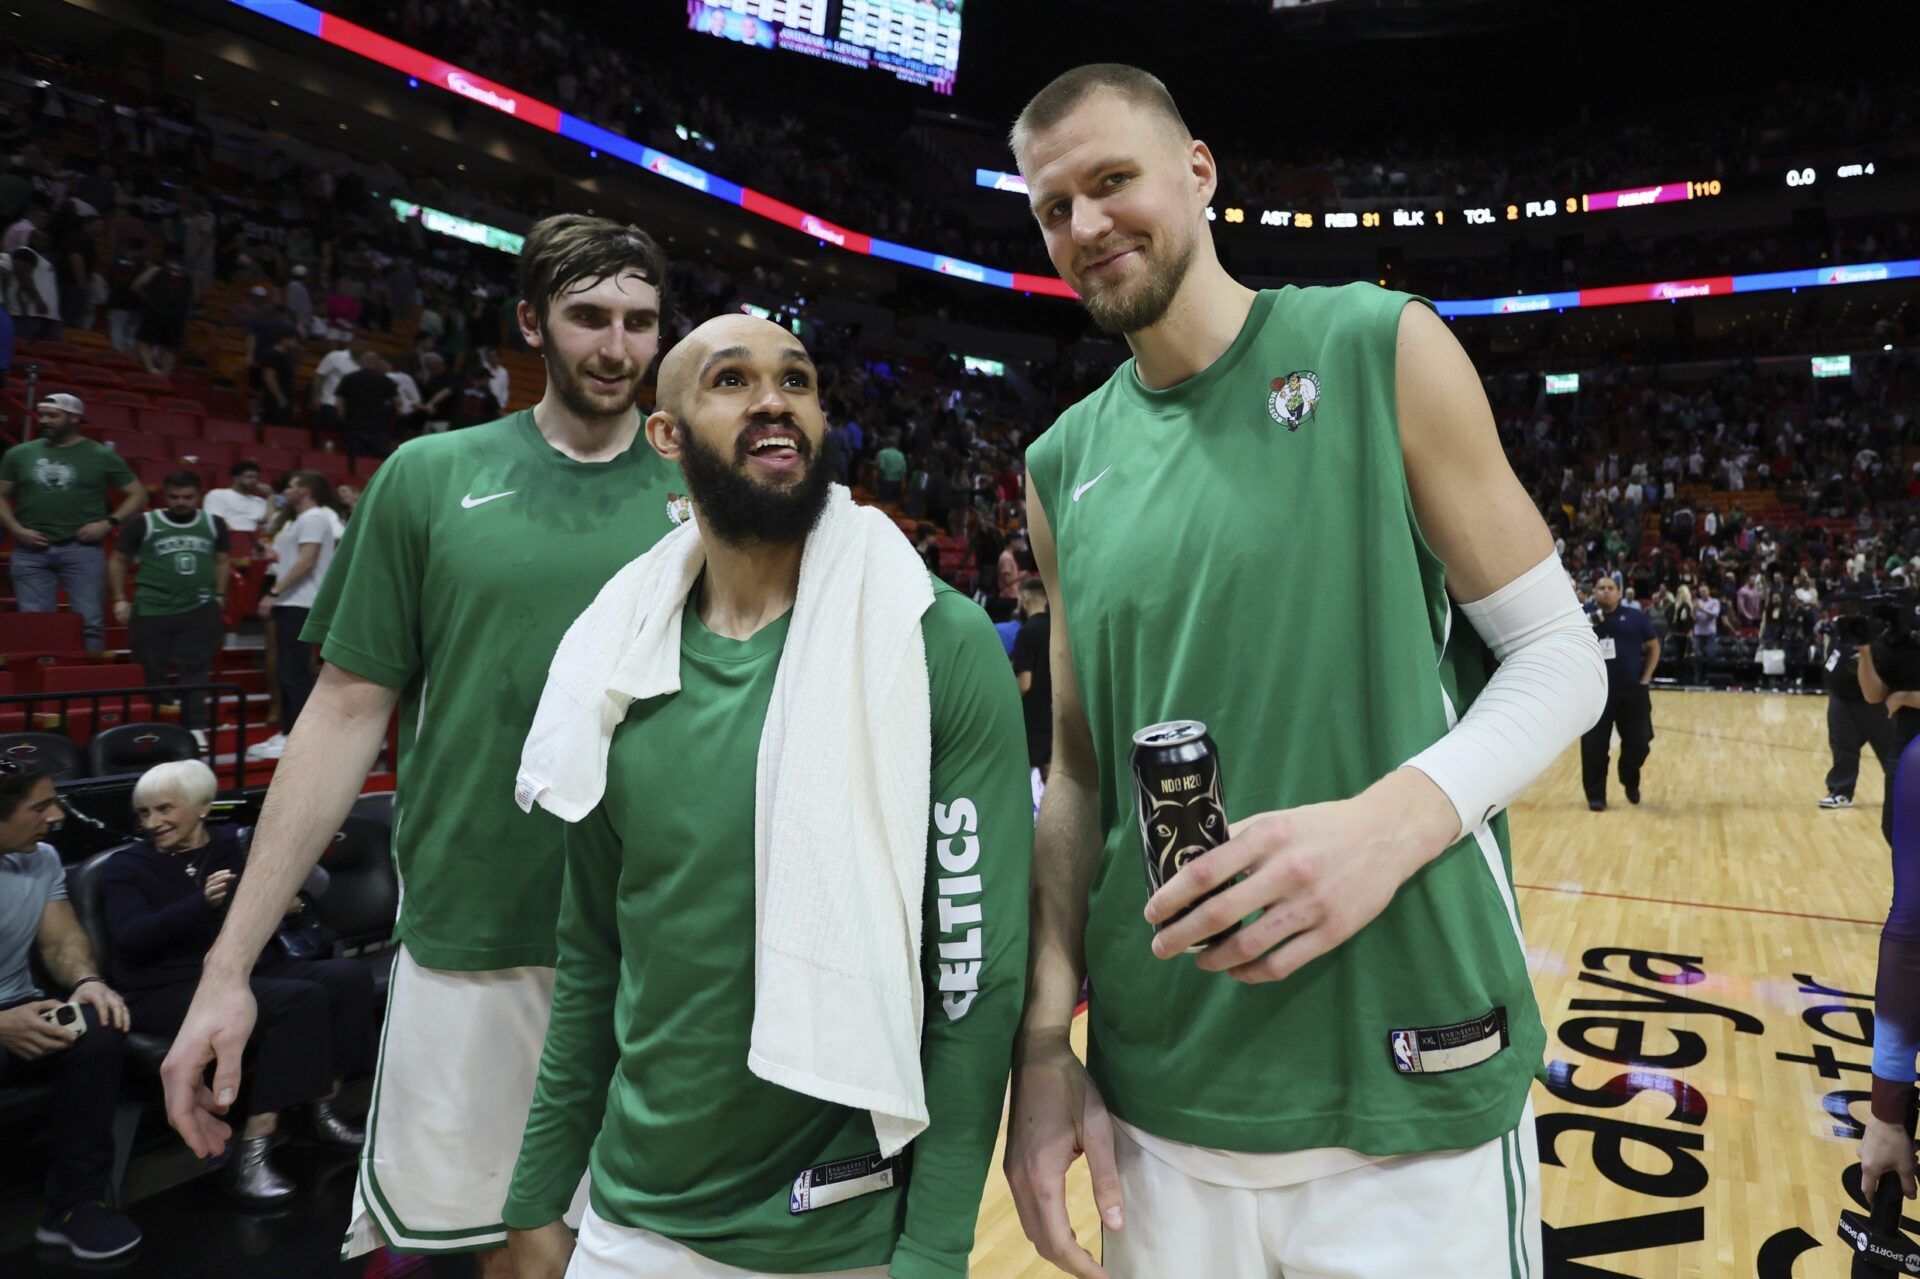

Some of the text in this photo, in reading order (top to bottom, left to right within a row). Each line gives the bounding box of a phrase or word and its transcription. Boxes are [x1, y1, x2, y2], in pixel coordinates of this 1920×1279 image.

[1786, 168, 1816, 187] 0.0
[1864, 162, 1875, 175] 4
[1694, 180, 1721, 197] 110
[1261, 210, 1292, 226] AST
[1325, 213, 1358, 228] REB
[1362, 212, 1380, 227] 31
[1393, 209, 1424, 226] BLK
[1435, 210, 1443, 225] 1
[1463, 208, 1496, 224] TOL
[1506, 205, 1518, 220] 2
[1526, 200, 1557, 218] FLS
[1566, 197, 1577, 213] 3
[1306, 372, 1321, 401] CELTICS
[1268, 391, 1283, 423] BOSTON
[934, 797, 982, 1021] CELTICS
[1839, 1219, 1858, 1239] SPORTS
[1869, 1244, 1904, 1262] SPORTS
